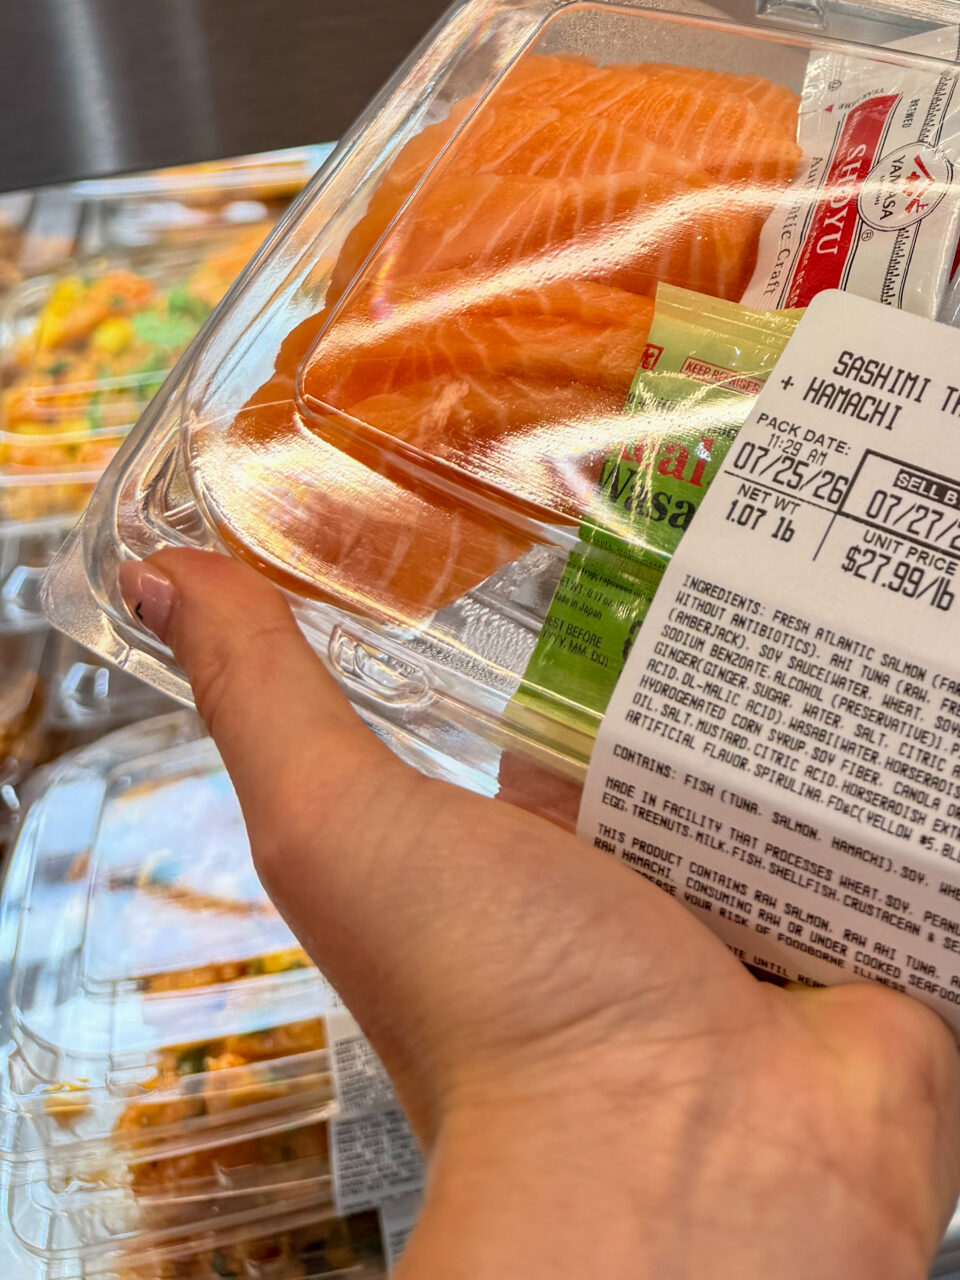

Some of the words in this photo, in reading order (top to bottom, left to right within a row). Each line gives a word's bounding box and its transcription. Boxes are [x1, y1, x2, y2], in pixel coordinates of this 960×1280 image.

[902, 98, 920, 128] BREWED
[780, 156, 824, 240] Autntic
[815, 143, 867, 255] SHOYU
[762, 247, 791, 297] Craft
[685, 360, 711, 378] KEEP
[831, 349, 931, 403] SASHIMI
[801, 375, 903, 431] HAMACHI
[755, 412, 801, 438] PACK
[802, 428, 851, 456] DATE:
[766, 432, 803, 457] 11:29
[806, 447, 828, 466] AM
[732, 440, 849, 505] 07/25/26
[896, 472, 939, 499] SELL
[725, 498, 767, 530] 1.07
[770, 515, 795, 543] lb
[736, 482, 772, 504] NET
[773, 495, 801, 514] WT
[862, 528, 904, 554] UNIT
[904, 545, 959, 576] PRICE
[565, 622, 603, 650] BEFORE
[660, 624, 705, 652] SODIUM
[675, 590, 726, 620] WITHOUT
[829, 653, 853, 671] AHI
[860, 664, 890, 687] TUNA
[682, 574, 765, 615] INGREDIENTS:
[772, 609, 810, 634] FRESH
[814, 627, 875, 660] ATLANTIC
[879, 653, 926, 681] SALMON
[758, 644, 783, 662] SOY
[625, 709, 694, 749] ARTIFICIAL
[639, 674, 726, 720] HYDROGENATED
[730, 713, 762, 735] CORN
[892, 781, 940, 810] CANOLA
[612, 743, 676, 779] CONTAINS:
[683, 773, 715, 796] FISH
[898, 742, 946, 771] CITRIC
[605, 775, 635, 798] MADE
[641, 791, 657, 807] IN
[662, 799, 722, 832] FACILITY
[729, 827, 758, 849] THAT
[763, 843, 833, 881] PROCESSES
[593, 836, 615, 855] RAW
[685, 876, 752, 914] CONSUMING
[757, 908, 781, 927] RAW
[786, 921, 803, 936] OR
[809, 930, 848, 956] UNDER
[854, 950, 901, 979] COOKED
[598, 822, 625, 843] THIS
[631, 837, 682, 866] PRODUCT
[688, 861, 747, 896] CONTAINS
[753, 889, 777, 909] RAW
[842, 928, 867, 947] RAW
[872, 942, 896, 960] AHI
[753, 954, 790, 978] UNTIL
